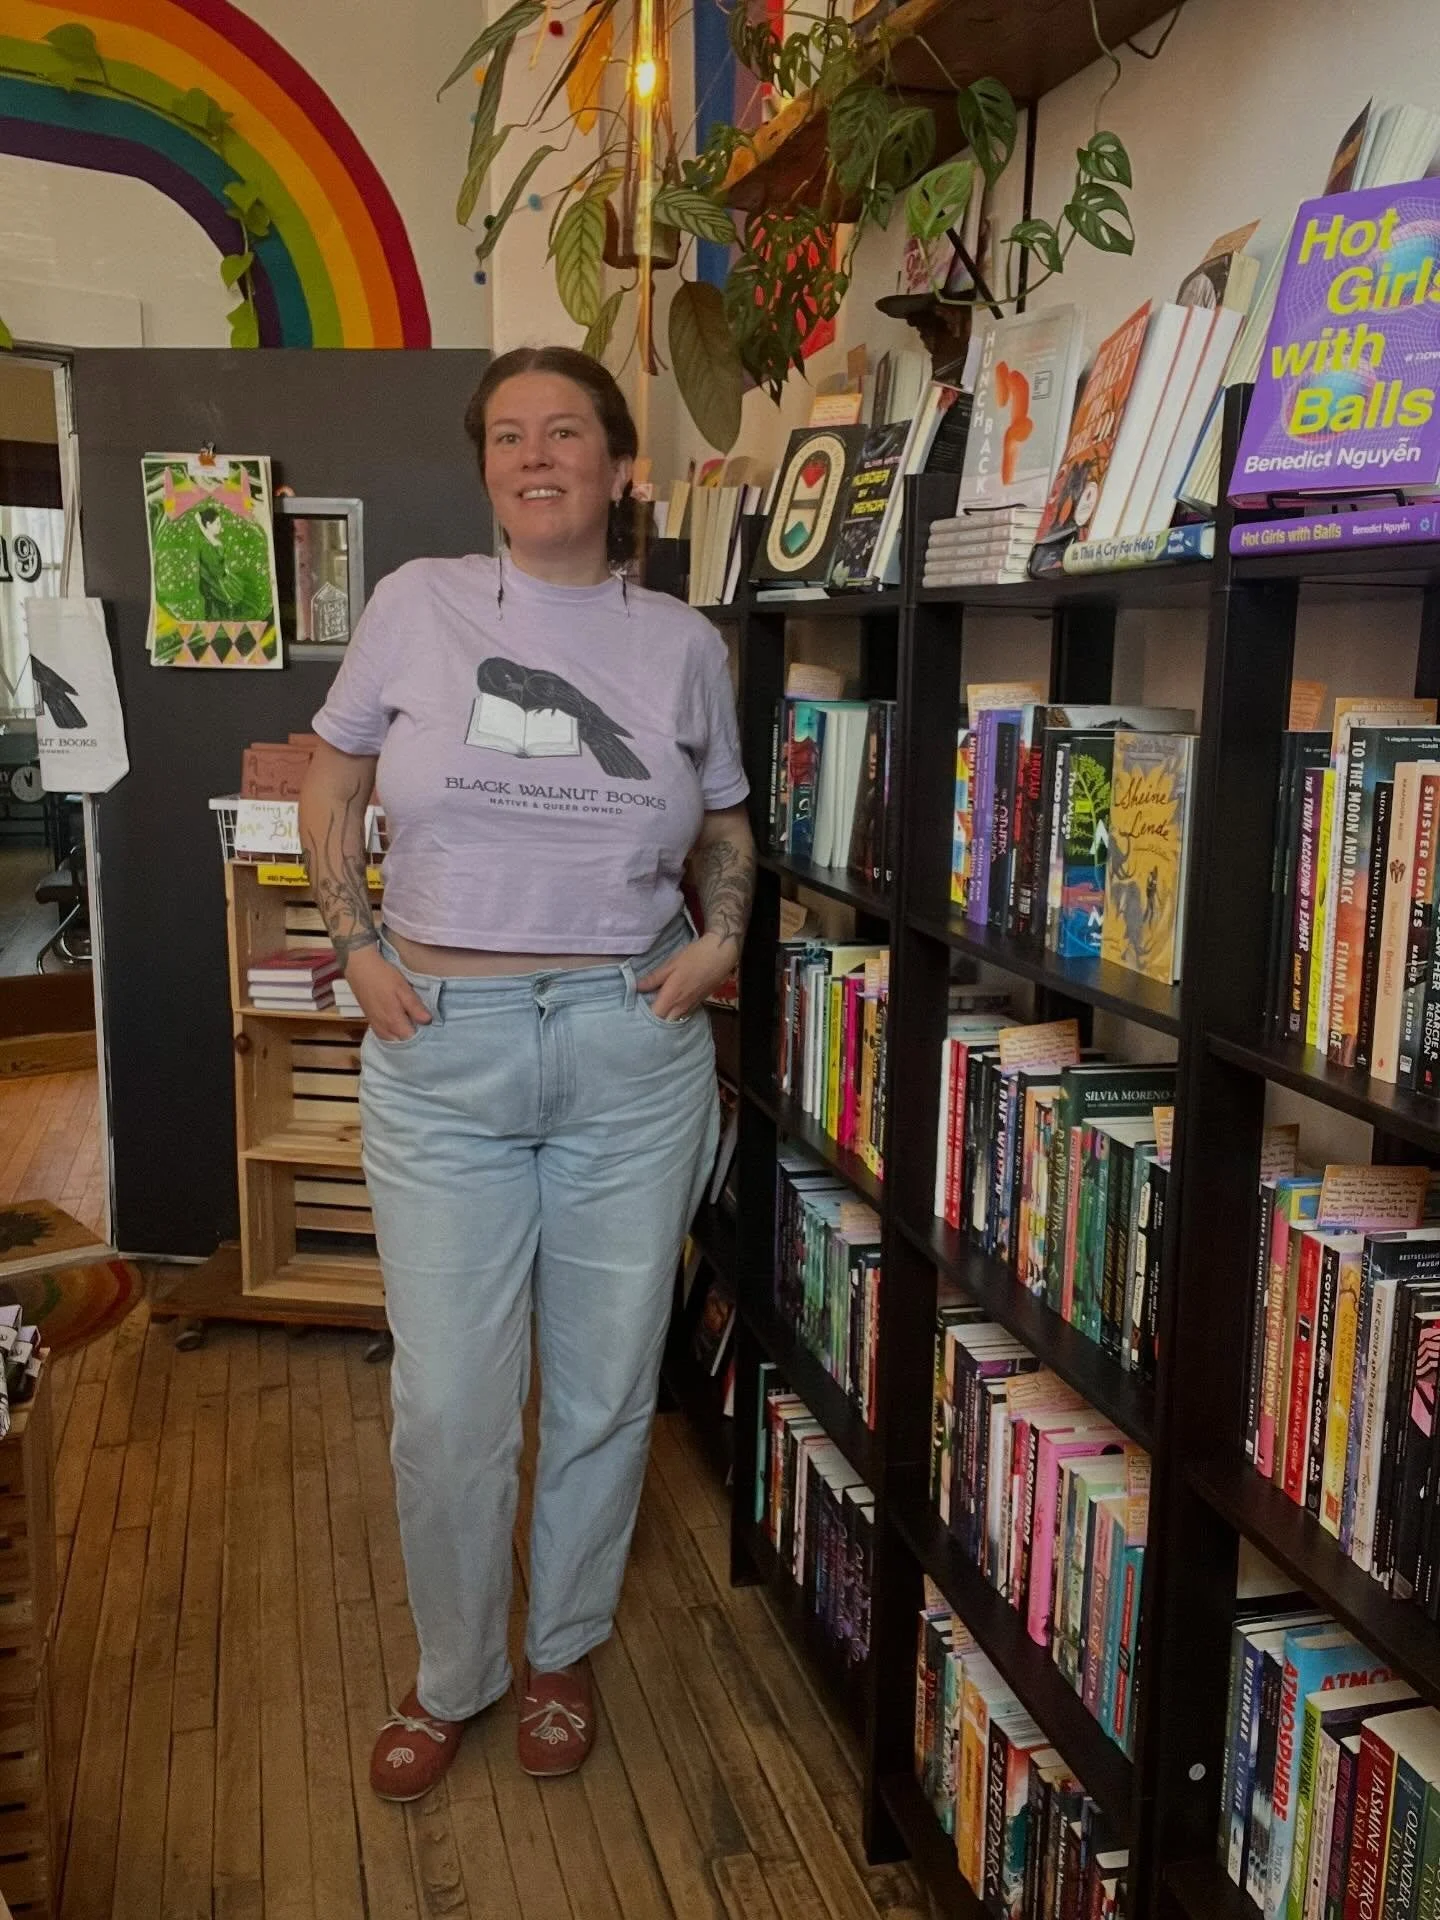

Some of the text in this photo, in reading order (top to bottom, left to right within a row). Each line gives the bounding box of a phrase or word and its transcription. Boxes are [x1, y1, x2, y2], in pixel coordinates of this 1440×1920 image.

[1298, 207, 1399, 263] Hot
[1327, 255, 1440, 315] Girls
[1271, 323, 1385, 379] with
[1287, 380, 1434, 436] Balls
[1244, 449, 1332, 474] Benedict
[1080, 547, 1094, 560] This
[1096, 546, 1102, 558] A
[1104, 544, 1117, 561] Cry
[1135, 538, 1154, 553] Help
[1241, 523, 1342, 547] Hot Girls with Balls
[59, 738, 97, 747] BOOKS
[445, 777, 667, 810] BLACK WALNUT BOOKS
[490, 798, 527, 808] NATIVE
[543, 803, 578, 812] QUEER
[582, 805, 622, 814] OWNED
[1302, 797, 1314, 832] TRUTH
[1378, 791, 1387, 822] MOON
[1340, 740, 1366, 905] TO THE MOON AND BACK
[1301, 834, 1313, 896] ACCORDING
[1372, 846, 1382, 895] TURNING
[1413, 785, 1434, 928] SINISTER GRAVES
[1299, 909, 1309, 952] EMBER
[1369, 899, 1379, 938] LEAVES
[1334, 941, 1349, 989] ELIANA
[1409, 945, 1419, 983] MARCIE
[1330, 993, 1344, 1049] RAMAGE
[1424, 1003, 1435, 1054] RENDON
[1085, 1090, 1119, 1101] SILVIA
[1270, 1264, 1283, 1328] ARCHIVE
[1322, 1273, 1332, 1328] COTTAGE
[1264, 1340, 1278, 1417] UNKNOWN
[1318, 1330, 1327, 1380] AROUND
[1291, 1351, 1306, 1474] TAIWAN TRAVELOGUE
[1312, 1398, 1322, 1445] CORNER
[1365, 1401, 1375, 1451] BEAUTIFUL
[1240, 1657, 1255, 1742] WITCHMARK
[1272, 1656, 1298, 1822] ATMOSPHERE
[986, 1772, 1003, 1888] DEEP DARK
[1366, 1771, 1386, 1858] JASMINE
[1347, 1794, 1368, 1900] TASHA SURI
[1388, 1828, 1403, 1886] TASHA
[1396, 1810, 1418, 1909] OLEANDER
